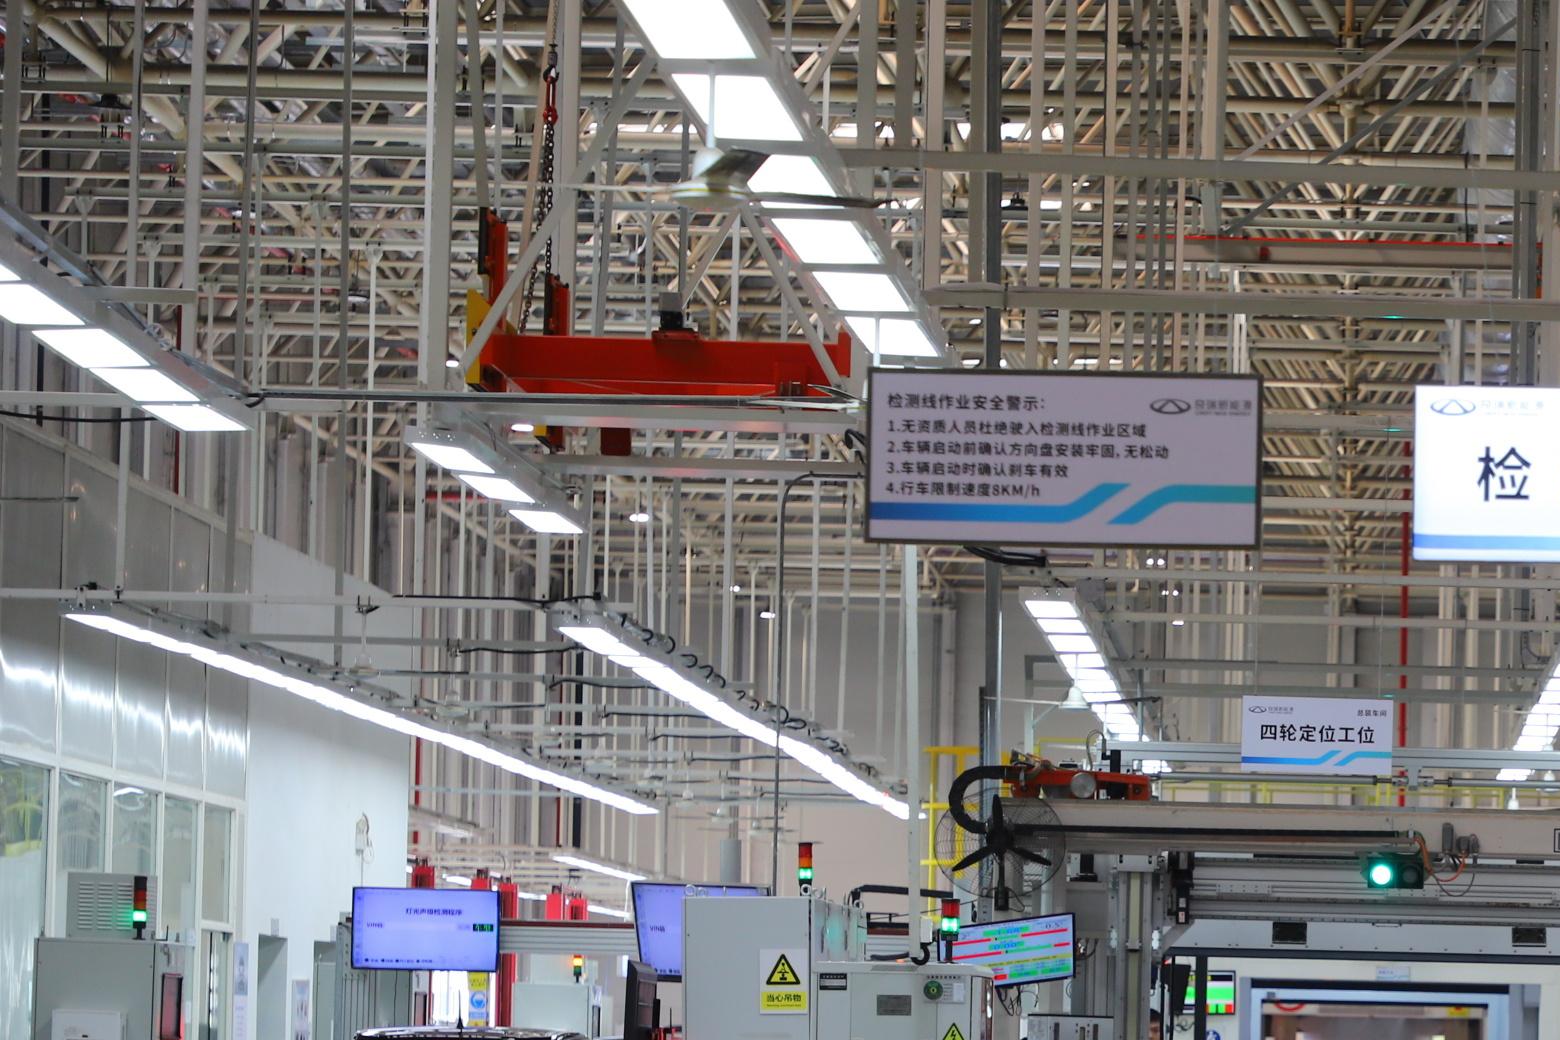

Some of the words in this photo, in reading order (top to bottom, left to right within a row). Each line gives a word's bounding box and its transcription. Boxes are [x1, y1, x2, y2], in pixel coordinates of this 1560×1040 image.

[887, 419, 1147, 438] 1.无资质人员杜绝驶入检测线作业区域
[886, 461, 1069, 478] 3.车辆启动时确认刹车有效
[885, 481, 1041, 498] 4.行车限制速度8KM/h
[1260, 724, 1375, 744] 四轮定位工位
[766, 993, 802, 1002] 当心吊物
